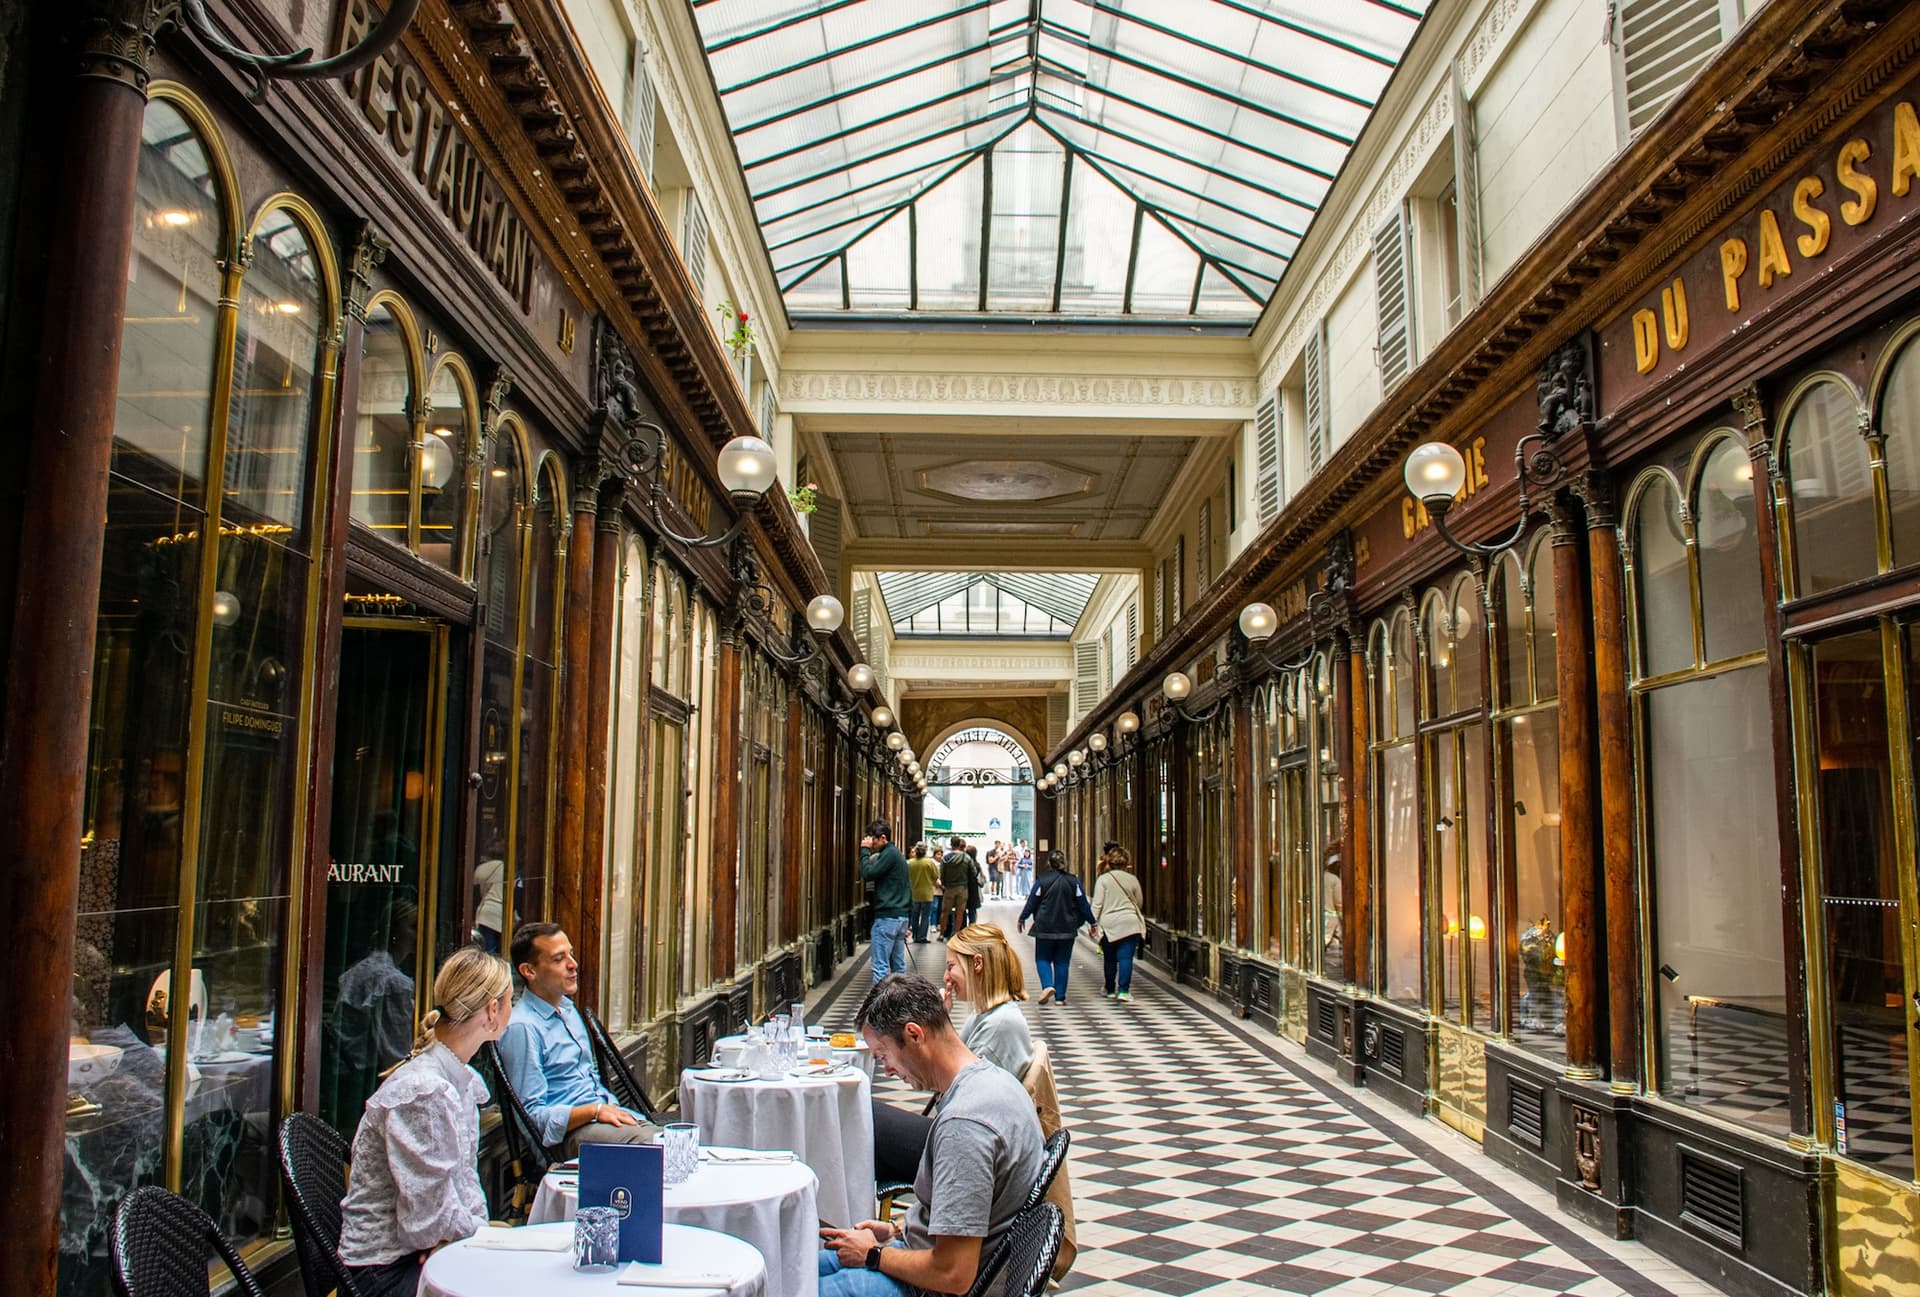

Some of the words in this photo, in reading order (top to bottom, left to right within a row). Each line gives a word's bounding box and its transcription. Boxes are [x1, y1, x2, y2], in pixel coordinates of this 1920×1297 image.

[332, 0, 539, 316] RESTAURANT
[1632, 277, 1690, 374] DU
[1718, 101, 1920, 313] PASSA
[558, 307, 575, 356] 19
[1401, 436, 1489, 540] GAIE
[223, 711, 244, 726] FILIPE
[327, 863, 404, 883] AURANT
